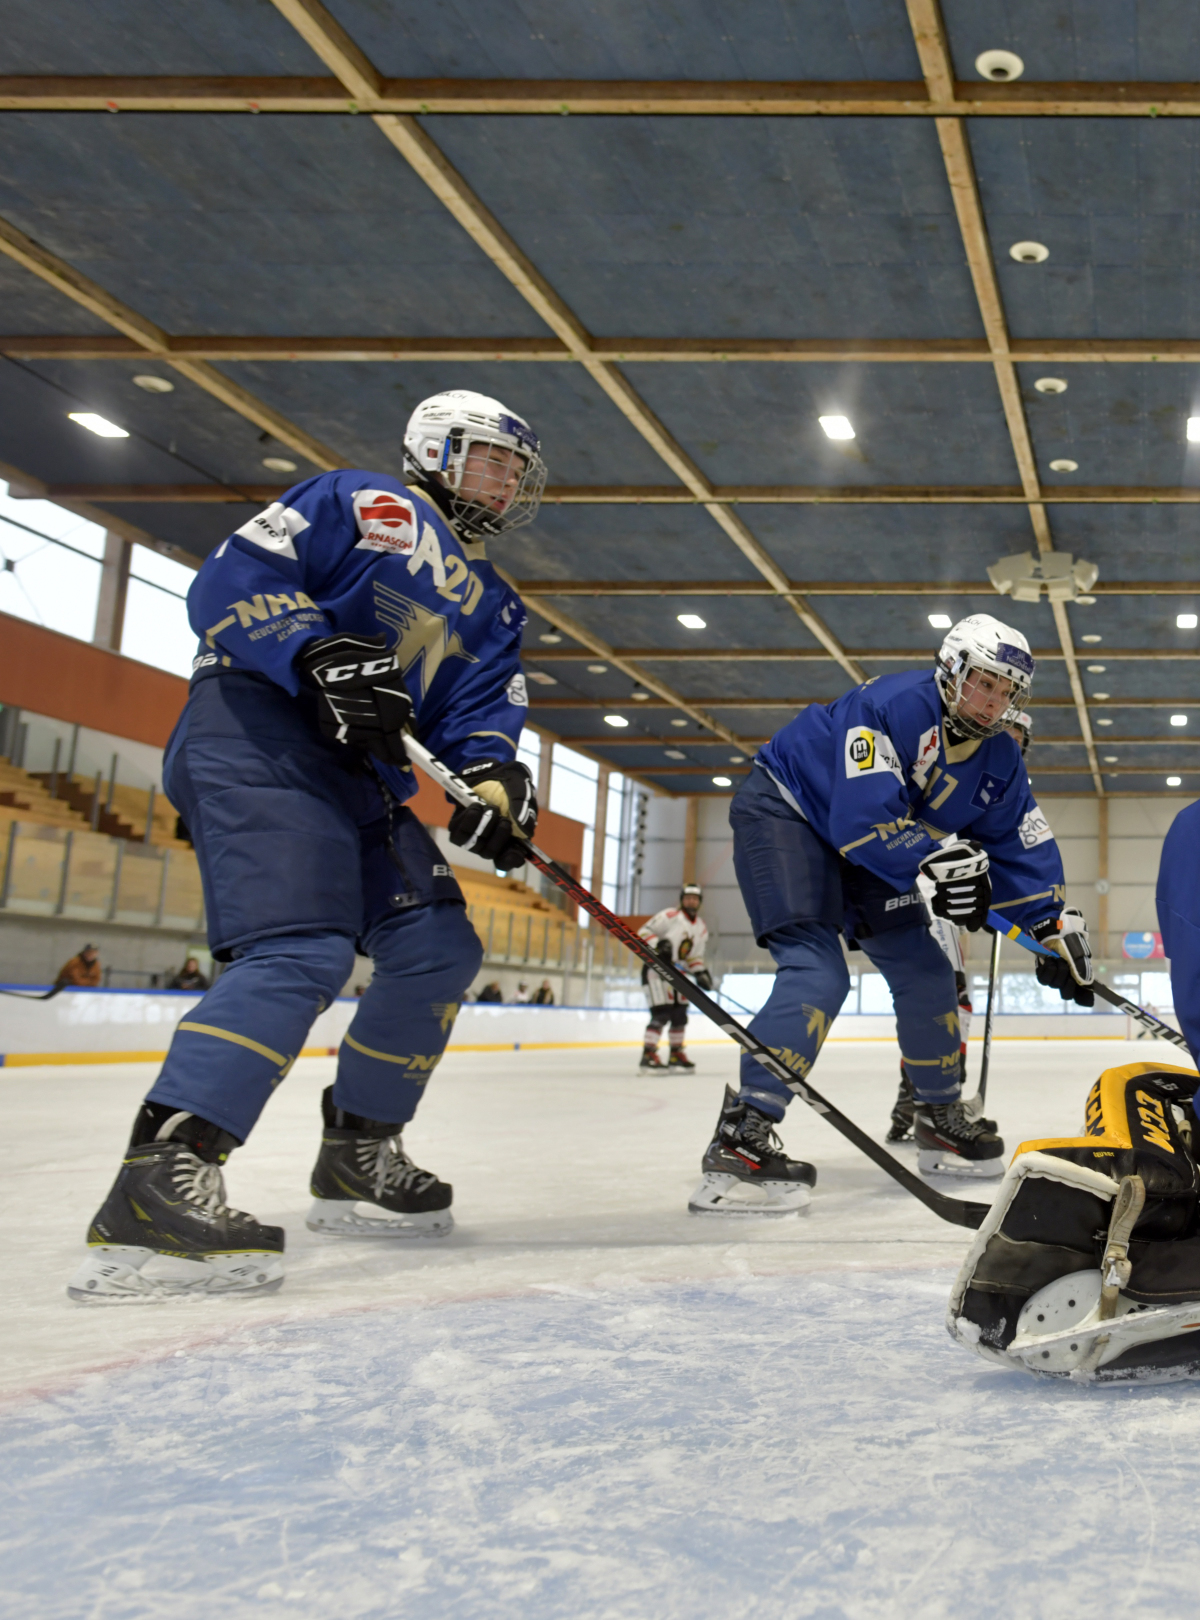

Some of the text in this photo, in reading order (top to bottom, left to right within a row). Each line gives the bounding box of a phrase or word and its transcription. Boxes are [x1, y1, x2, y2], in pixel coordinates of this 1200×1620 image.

[226, 591, 321, 628] NHA
[436, 554, 484, 616] 20
[652, 963, 675, 982] TEAM
[720, 1024, 832, 1115] CCM
[1135, 1089, 1175, 1154] CCM
